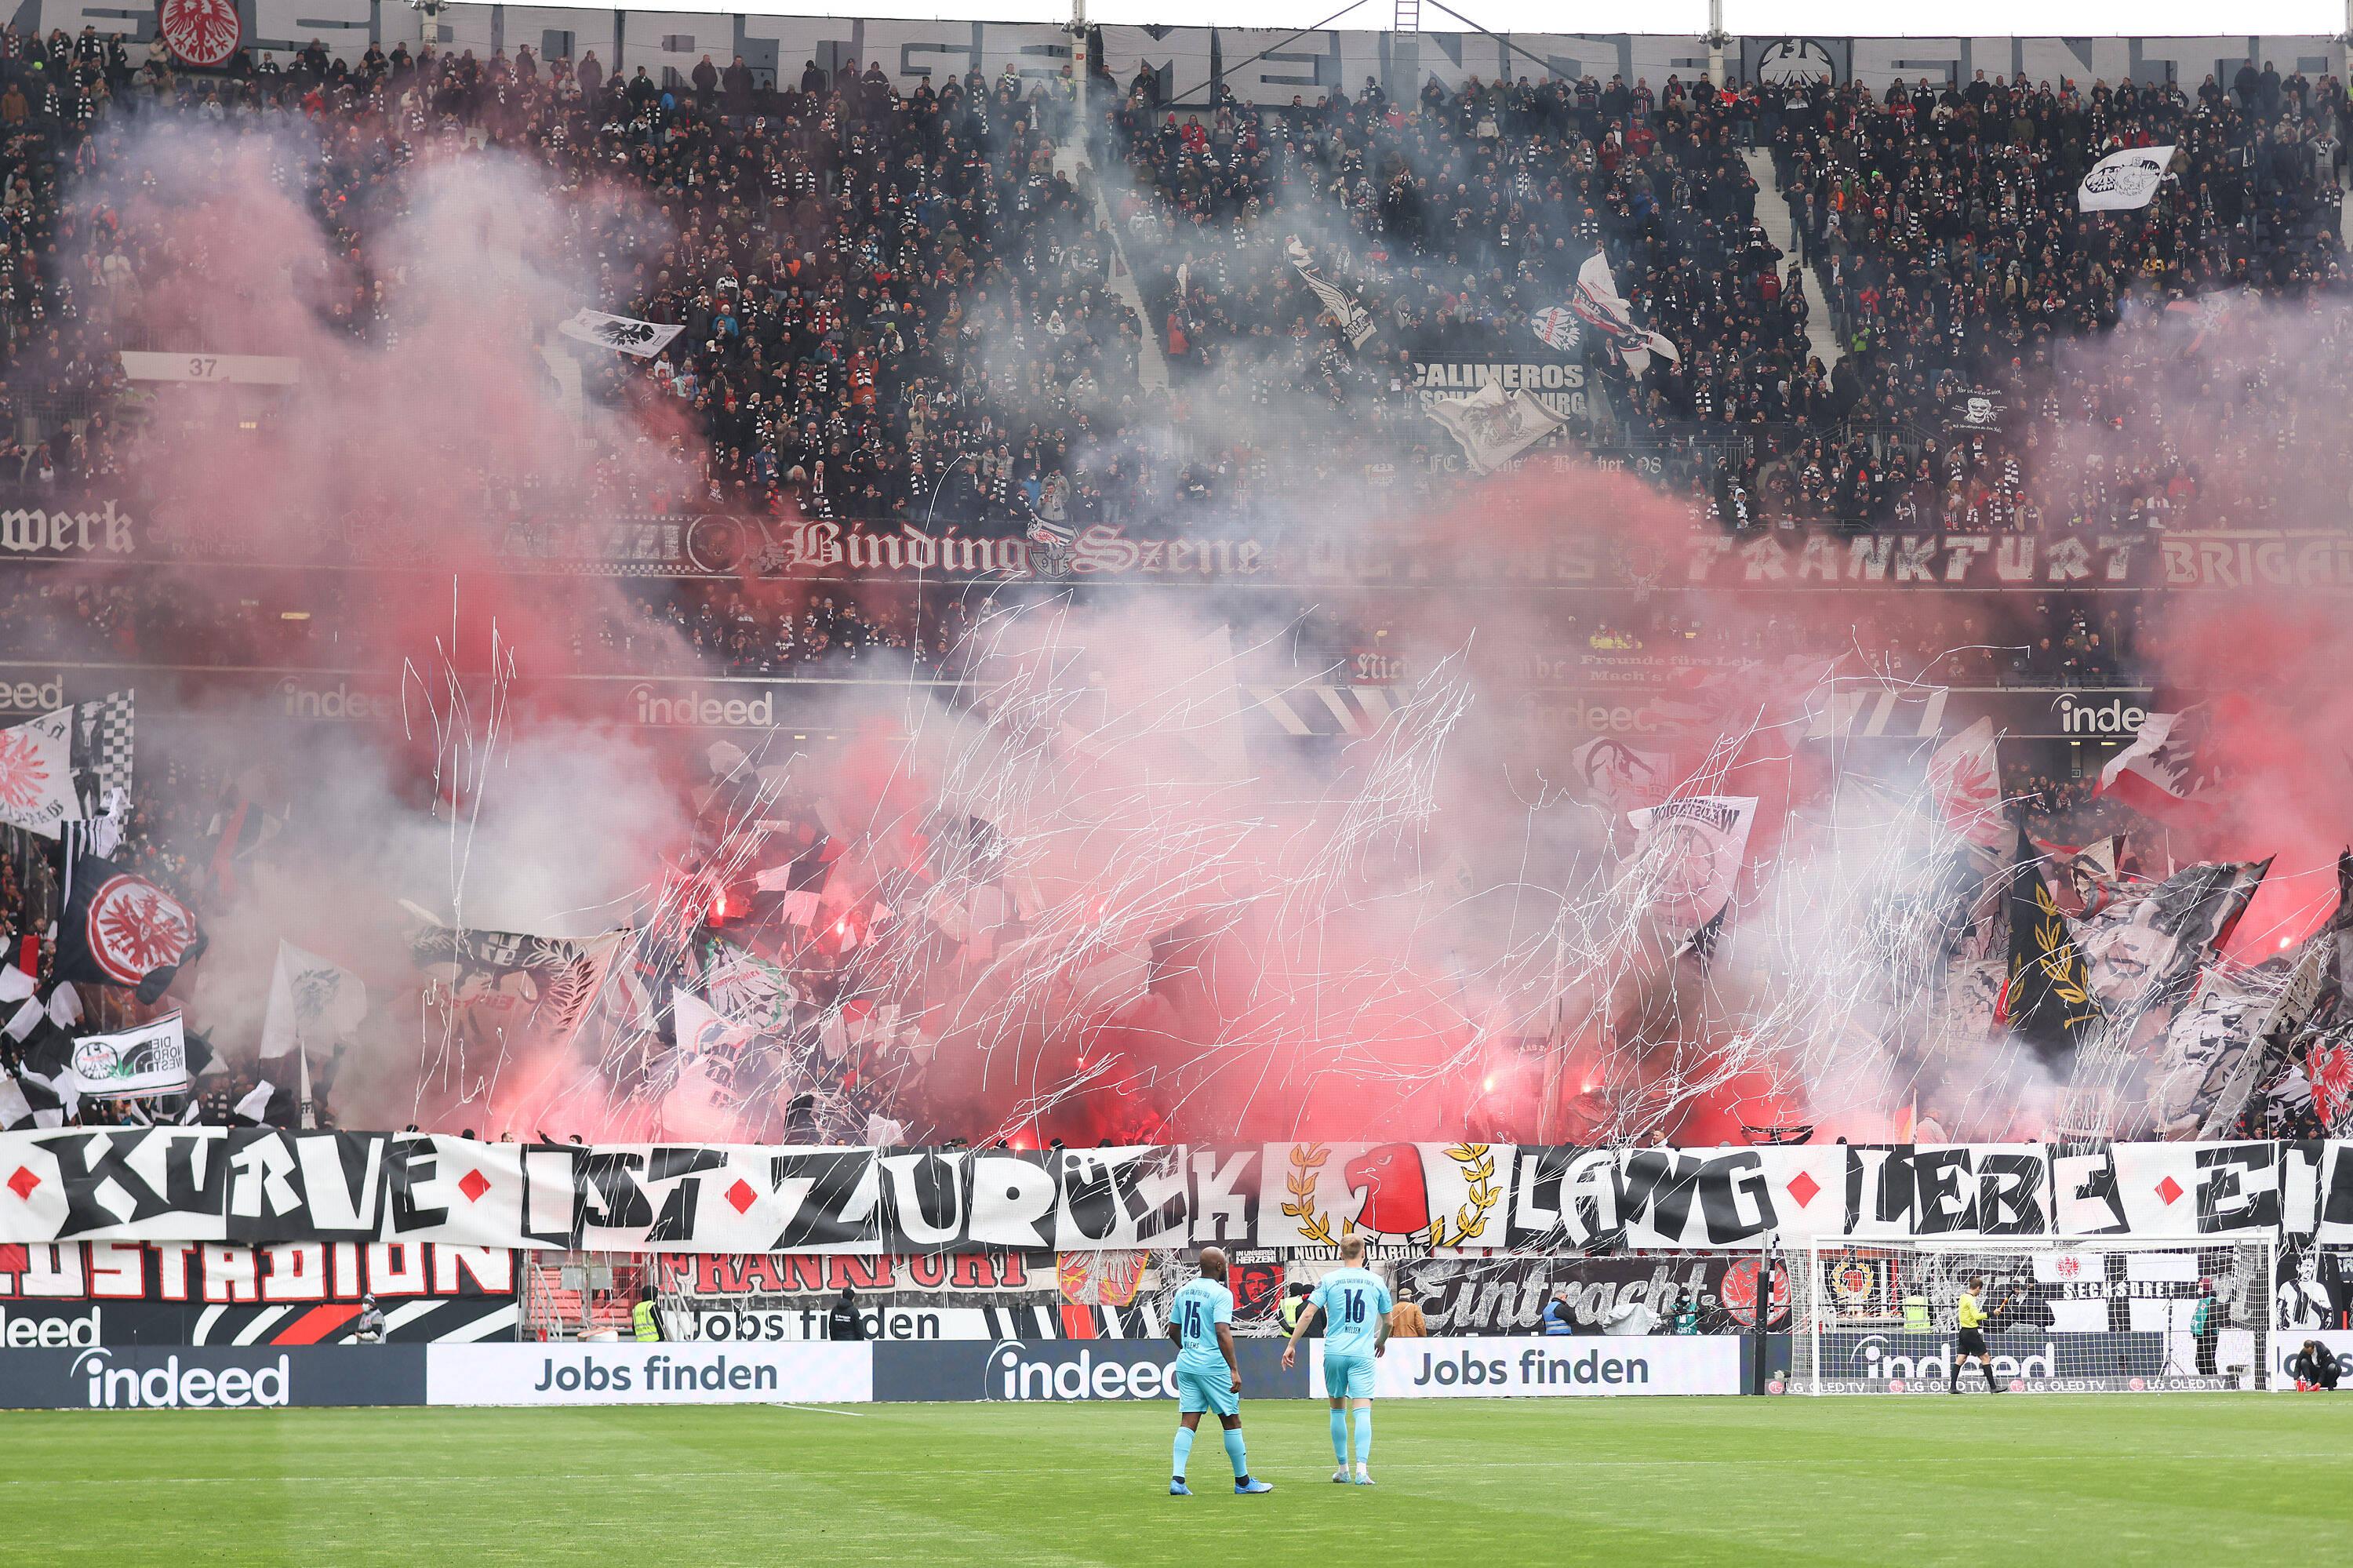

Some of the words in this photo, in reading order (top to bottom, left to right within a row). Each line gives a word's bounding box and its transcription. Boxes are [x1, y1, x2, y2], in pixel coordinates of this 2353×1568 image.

[189, 358, 217, 377] 37
[1, 498, 135, 554] werk
[784, 521, 1032, 579] Binding
[1071, 524, 1264, 573] Szene
[1688, 534, 2145, 583] FRANKFURT
[1580, 654, 1666, 666] Freunde
[1589, 671, 1662, 682] Mach's
[638, 691, 773, 726] indeed
[2063, 698, 2148, 733] inde
[31, 1131, 449, 1241] KURVE
[523, 1144, 728, 1249] IST
[1847, 1144, 2129, 1235] LEBE
[1295, 1246, 1341, 1261] NUOVA
[1369, 1246, 1426, 1261] UARDIA
[660, 1253, 1027, 1294] FRANKFURT
[1344, 1289, 1366, 1323] 16
[1409, 1257, 1708, 1328] Eintracht
[684, 1308, 784, 1341] Jobs
[799, 1309, 940, 1341] fiden
[1184, 1300, 1201, 1338] 15
[86, 1354, 289, 1406] indeed
[535, 1358, 631, 1393] Jobs
[643, 1356, 778, 1392] finden
[1413, 1352, 1507, 1387] Jobs
[1520, 1349, 1648, 1385] finden
[2147, 1380, 2166, 1390] LG
[2170, 1380, 2206, 1390] OLED
[2207, 1379, 2226, 1389] TV
[1785, 1382, 1804, 1393] LG
[1849, 1382, 1865, 1392] TV
[1906, 1381, 1925, 1392] LG
[1969, 1381, 1986, 1392] TV
[2027, 1381, 2045, 1392] LG
[2050, 1380, 2086, 1391] OLED
[2087, 1380, 2105, 1390] TV
